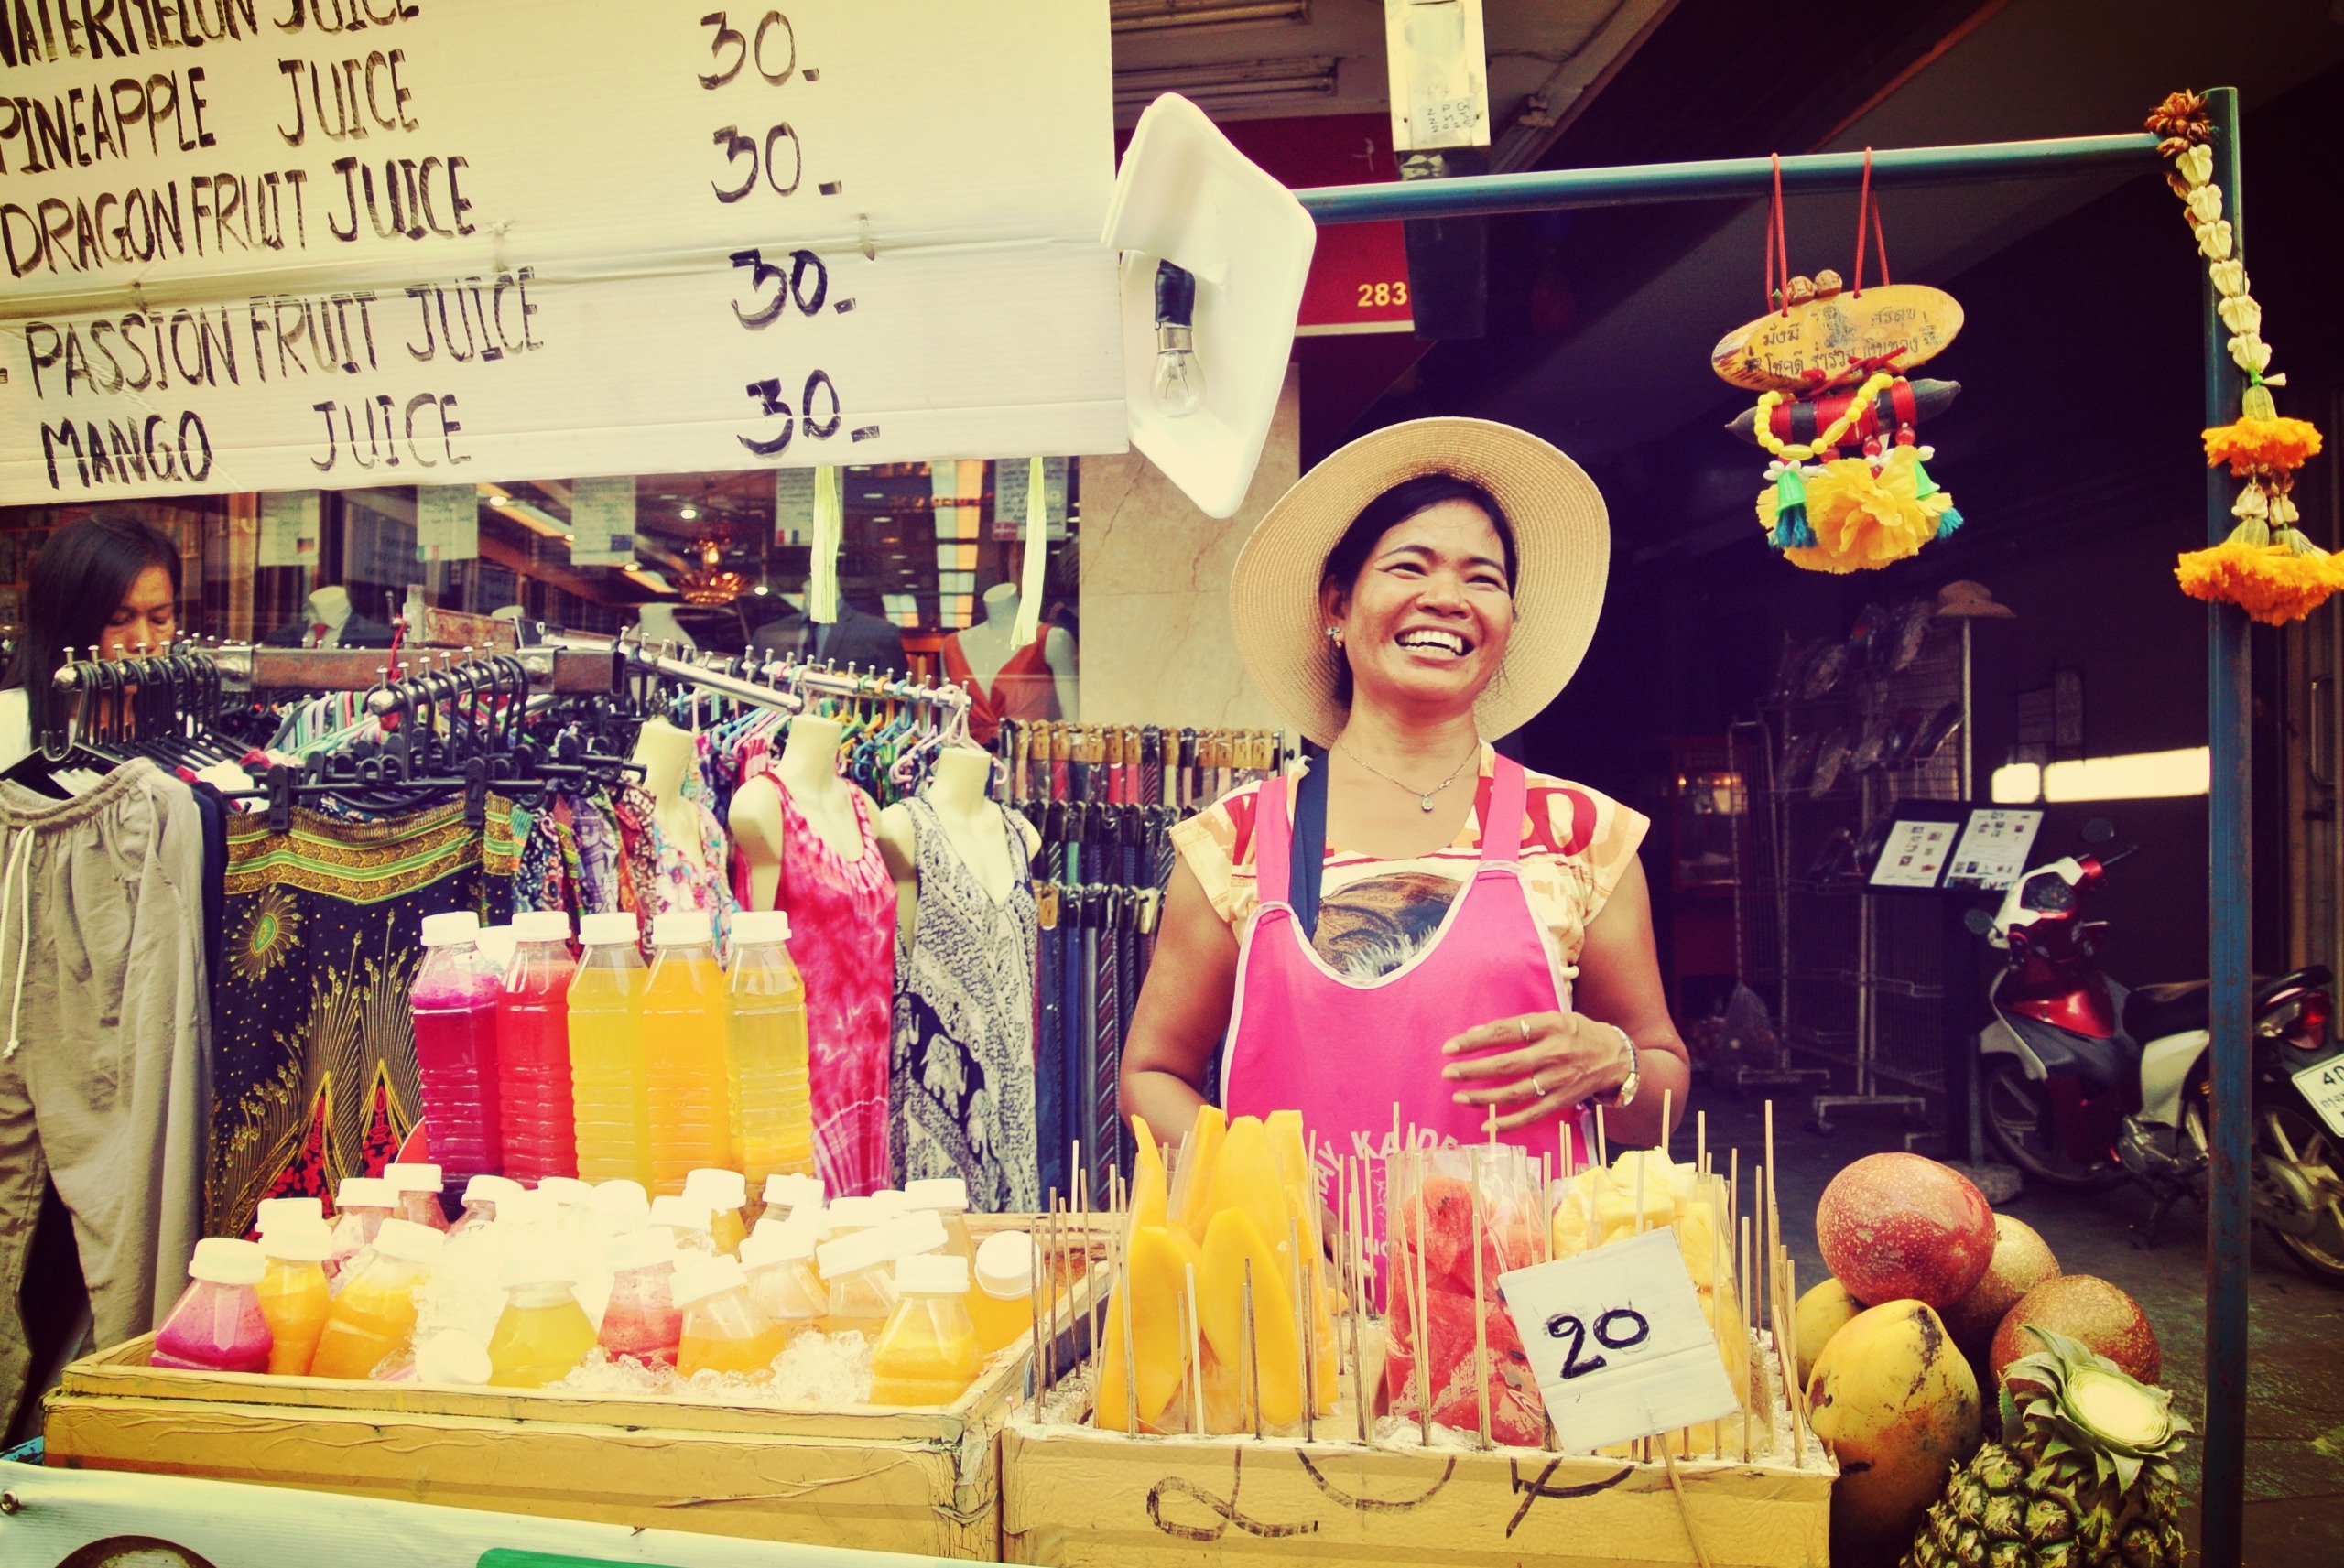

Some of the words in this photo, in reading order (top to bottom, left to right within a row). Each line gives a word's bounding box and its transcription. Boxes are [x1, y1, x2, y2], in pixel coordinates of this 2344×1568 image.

[0, 67, 217, 175] PINEAPPLE
[277, 49, 419, 146] JUICE
[328, 156, 476, 243] JUICE
[404, 266, 544, 362] JUICE
[1358, 282, 1407, 307] 283
[41, 410, 212, 491] MANGO
[310, 394, 472, 472] JUICE
[1546, 1309, 1649, 1379] 20
